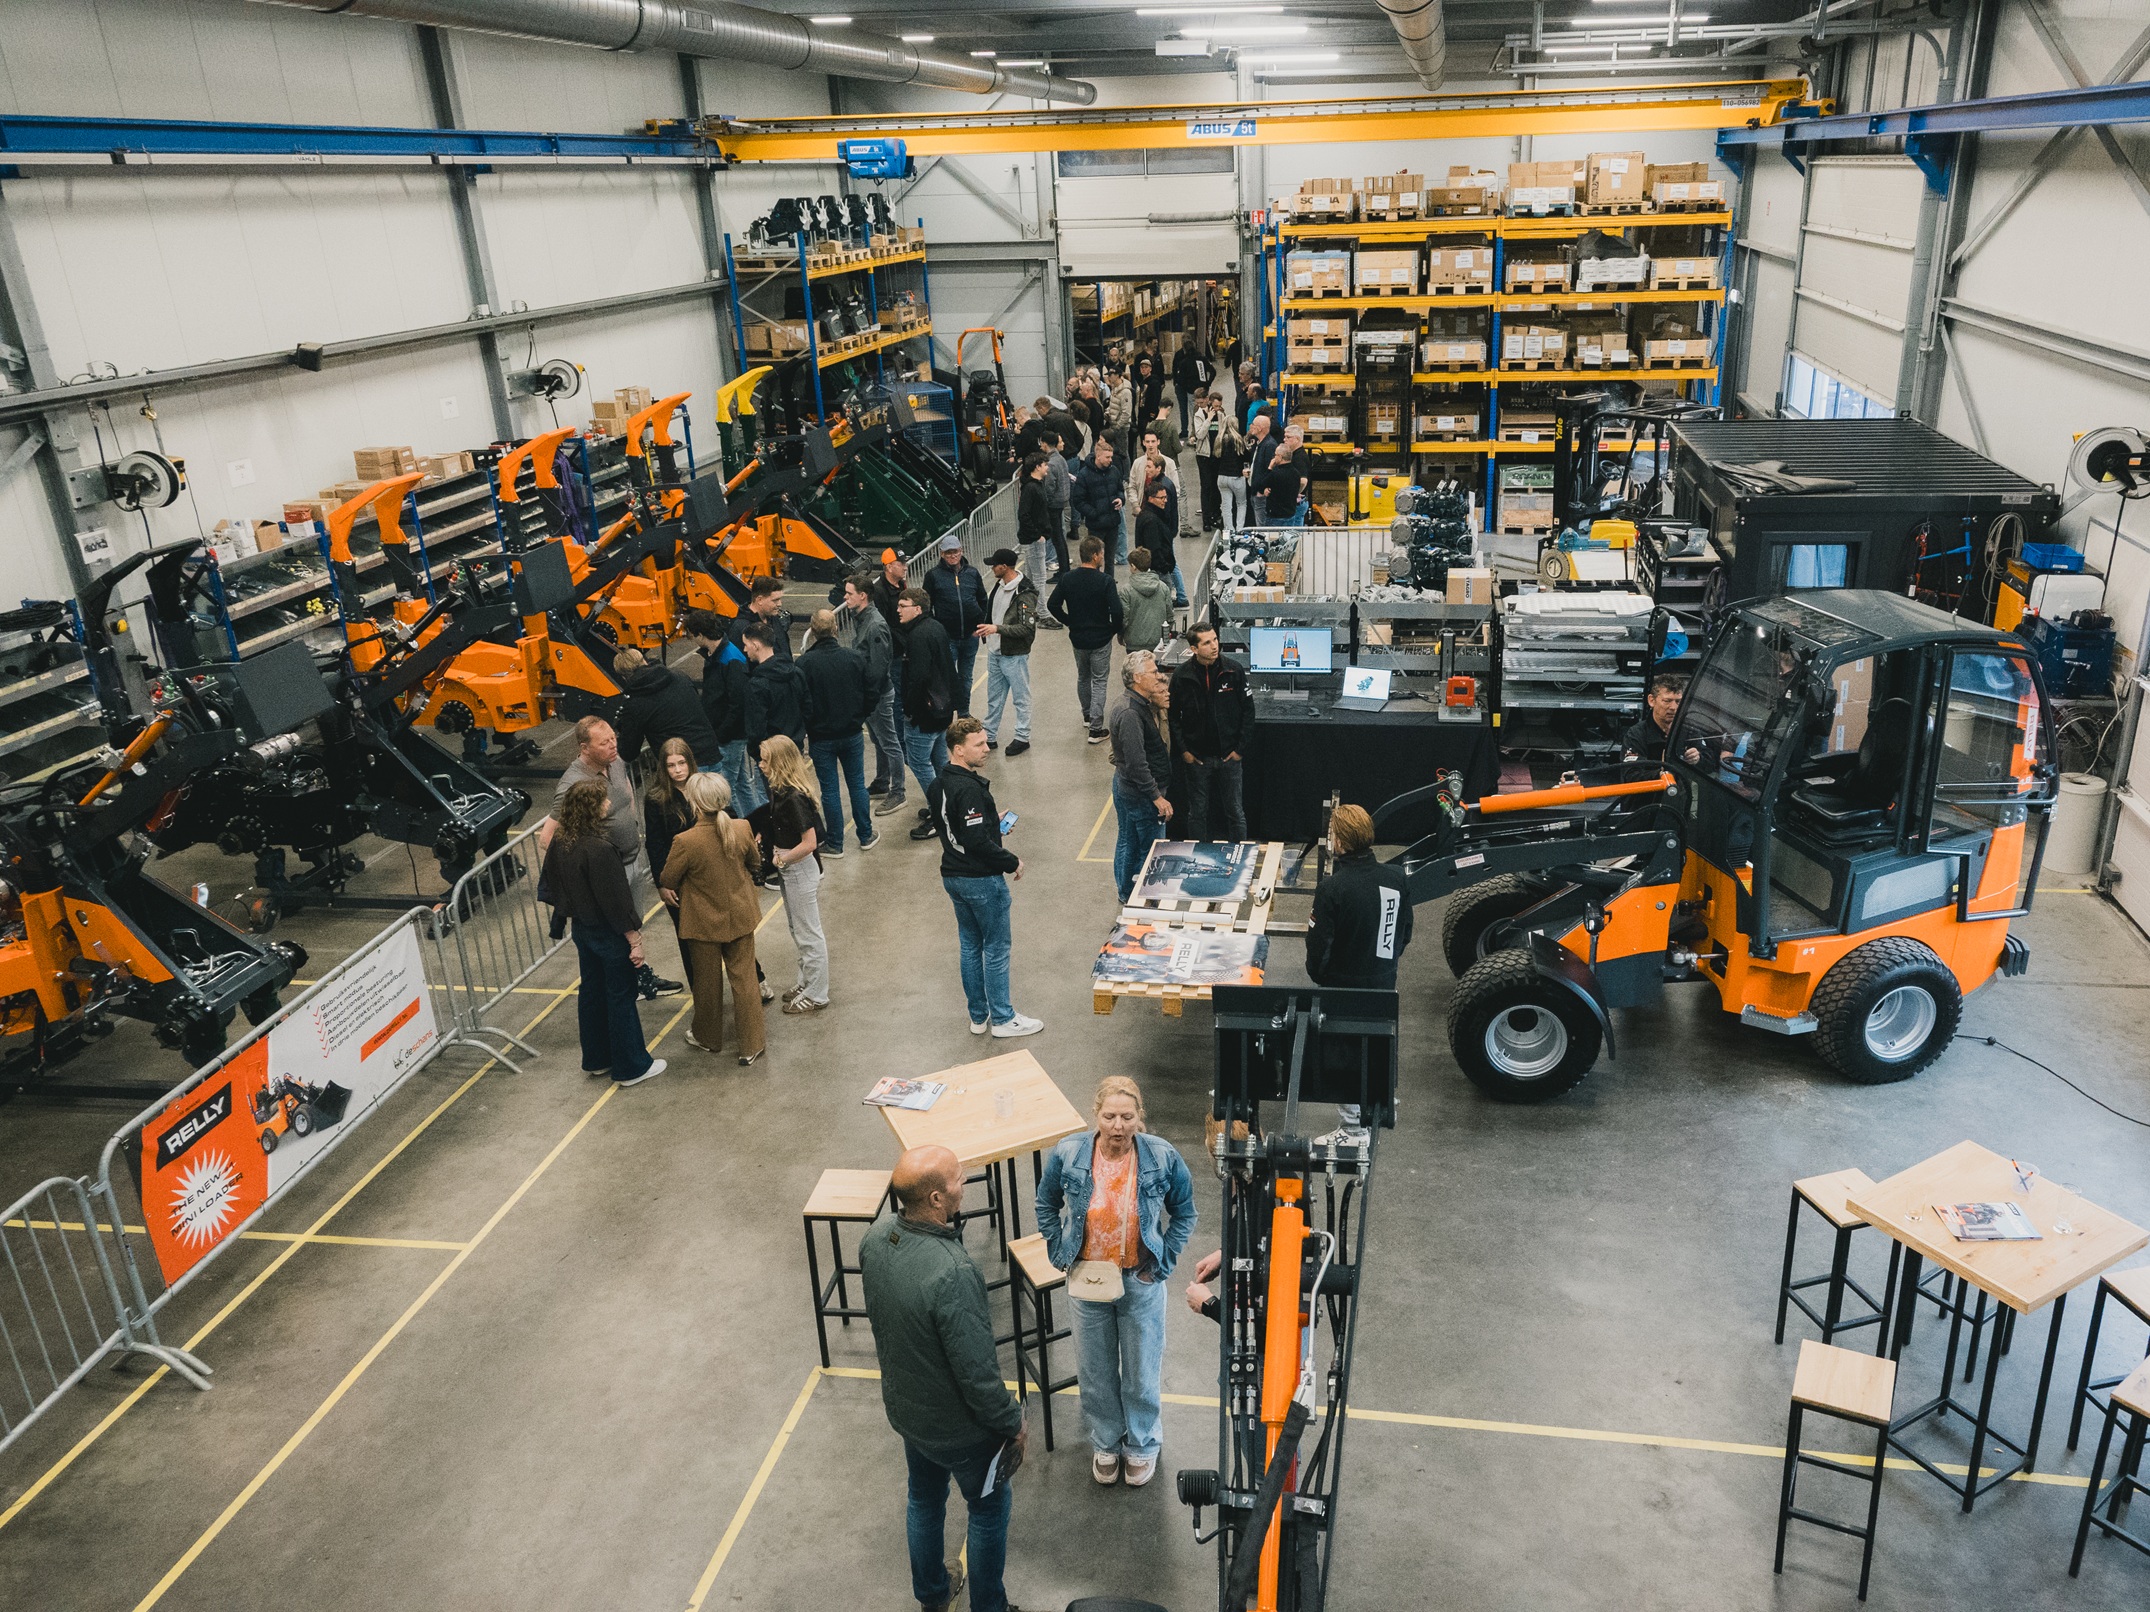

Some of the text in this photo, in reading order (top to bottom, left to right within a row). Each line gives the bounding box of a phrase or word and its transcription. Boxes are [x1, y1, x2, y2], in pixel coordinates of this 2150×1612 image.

[1191, 122, 1253, 134] ABUS 5t
[1300, 196, 1340, 205] SCIA
[1555, 417, 1563, 440] Yale
[2027, 714, 2035, 752] RELLY
[1383, 898, 1396, 951] RELLY
[1174, 942, 1193, 973] RELLY
[320, 964, 377, 1011] Gebruiksvriendelijk
[322, 985, 363, 1019] Smart modus
[324, 969, 393, 1027] Proportionele besturing
[327, 967, 406, 1035] Aanbouwdelen uitwisselbaar
[329, 1025, 348, 1044] Diesel
[355, 995, 384, 1022] elektrisch
[337, 1035, 349, 1047] drie
[350, 1013, 375, 1036] modellen
[375, 984, 408, 1013] beschikbaar
[404, 1029, 433, 1058] deschans
[165, 1096, 225, 1154] RELLY
[171, 1172, 243, 1236] MINI LOADER
[172, 1194, 195, 1216] THE
[196, 1171, 222, 1197] NEW
